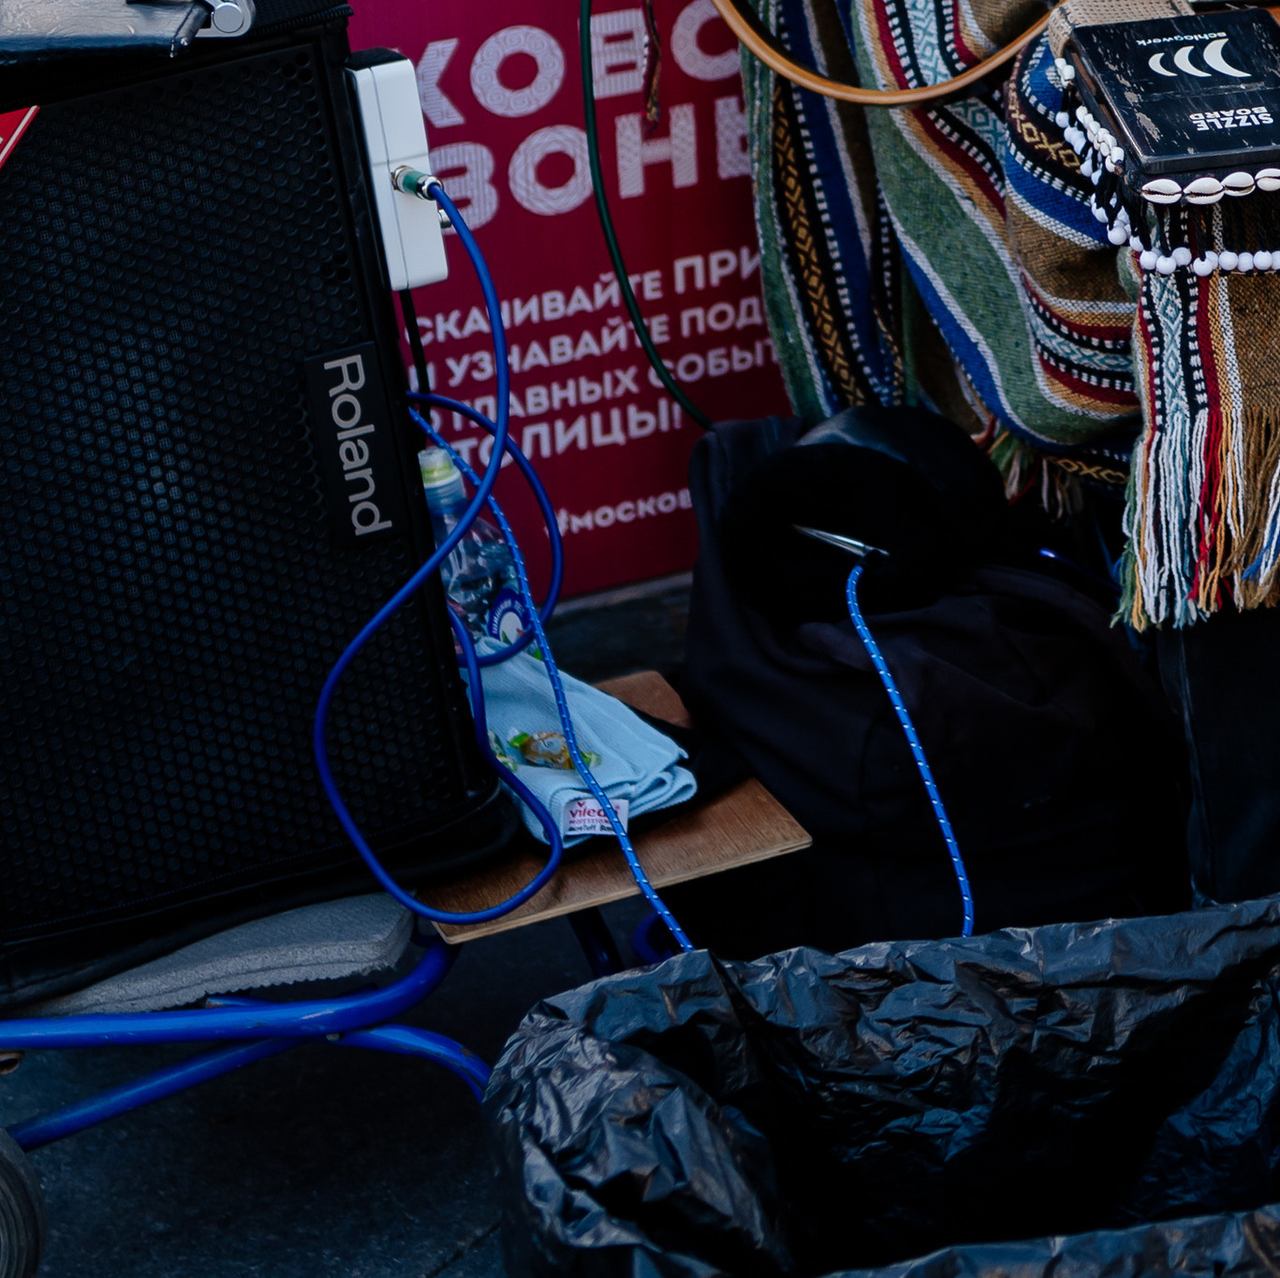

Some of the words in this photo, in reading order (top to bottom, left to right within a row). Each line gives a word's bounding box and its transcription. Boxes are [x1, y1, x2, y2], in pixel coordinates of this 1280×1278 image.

[1136, 32, 1227, 46] schlagwerk
[1189, 106, 1268, 120] BOARD
[1192, 113, 1274, 131] SIZZLE
[324, 354, 393, 536] Roland
